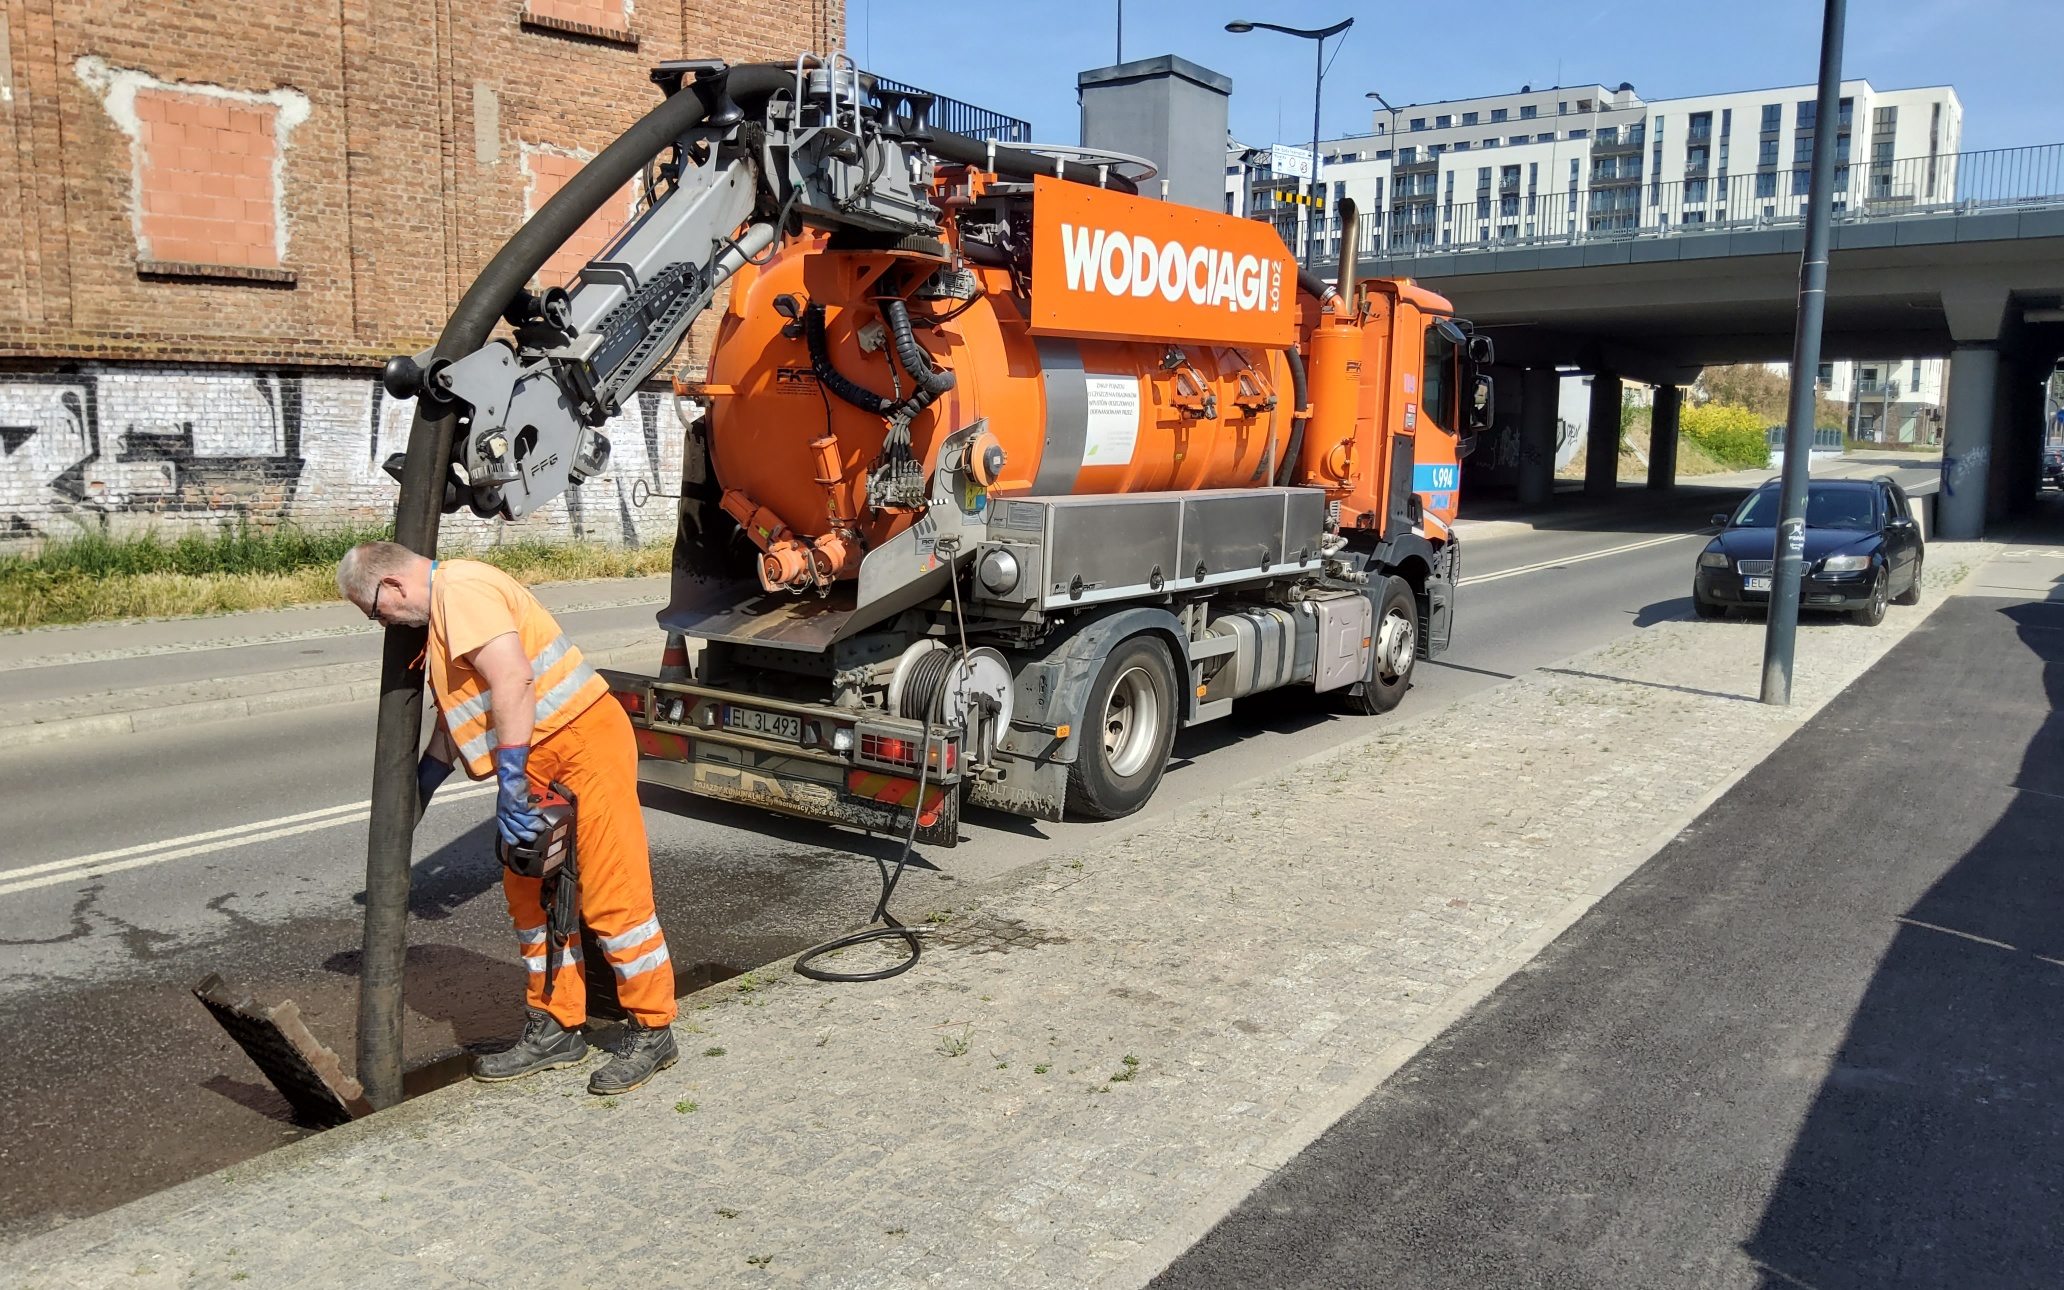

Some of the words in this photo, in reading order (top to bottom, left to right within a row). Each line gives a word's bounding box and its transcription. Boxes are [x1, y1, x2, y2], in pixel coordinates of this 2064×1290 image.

[1061, 223, 1269, 313] WODOCIĄGI
[1271, 260, 1282, 313] ŁÓDŹ
[1438, 467, 1453, 488] 994
[1752, 579, 1763, 588] EL
[733, 709, 749, 728] EL
[755, 713, 799, 736] 3L493
[977, 782, 1009, 796] AULT
